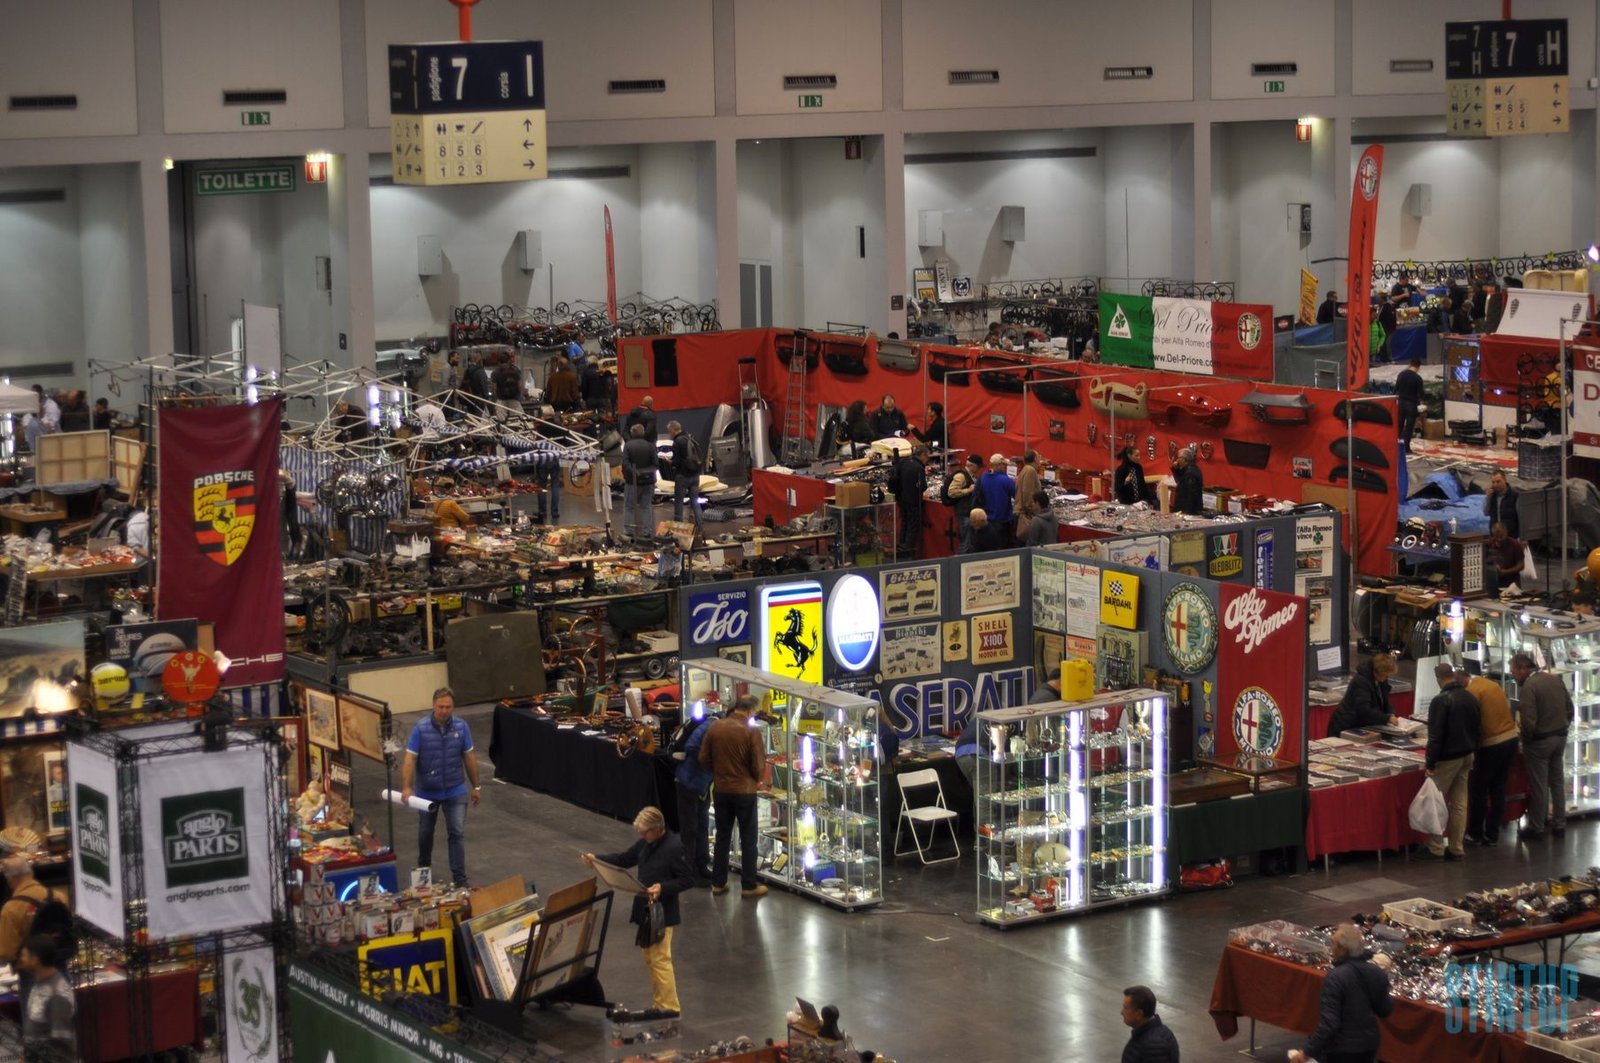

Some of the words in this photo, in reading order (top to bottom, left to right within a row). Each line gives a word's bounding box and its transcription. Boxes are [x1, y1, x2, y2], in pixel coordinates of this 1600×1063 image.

[1505, 32, 1517, 67] 7
[1546, 30, 1561, 65] H
[451, 57, 468, 100] 7
[499, 71, 510, 99] corsia
[439, 146, 446, 157] 8
[457, 145, 464, 156] 5
[475, 144, 482, 156] 6
[458, 166, 465, 176] 2
[475, 165, 482, 176] 3
[201, 171, 290, 190] TOILETTE
[1172, 336, 1184, 346] Alfa
[1185, 338, 1205, 349] Romeo
[193, 470, 255, 489] PORSCHE
[1312, 524, 1332, 532] Romeo
[717, 591, 747, 601] SERVIZIO
[1103, 595, 1133, 611] BARDAHL
[1224, 588, 1267, 630] Alfa
[977, 619, 1008, 632] SHELL
[1235, 601, 1298, 654] Romeo
[982, 633, 1003, 648] X-100
[978, 651, 997, 660] MOTOR
[999, 649, 1009, 657] OIL
[1171, 643, 1204, 663] MILANO
[183, 813, 226, 838] anglo
[174, 832, 241, 861] PARTS
[165, 883, 251, 904] angloparts.com
[288, 964, 348, 1007] AUSTIN-HEALEY
[357, 1002, 389, 1029] MORRIS
[390, 1018, 419, 1046] MINOR
[429, 1039, 443, 1059] MG
